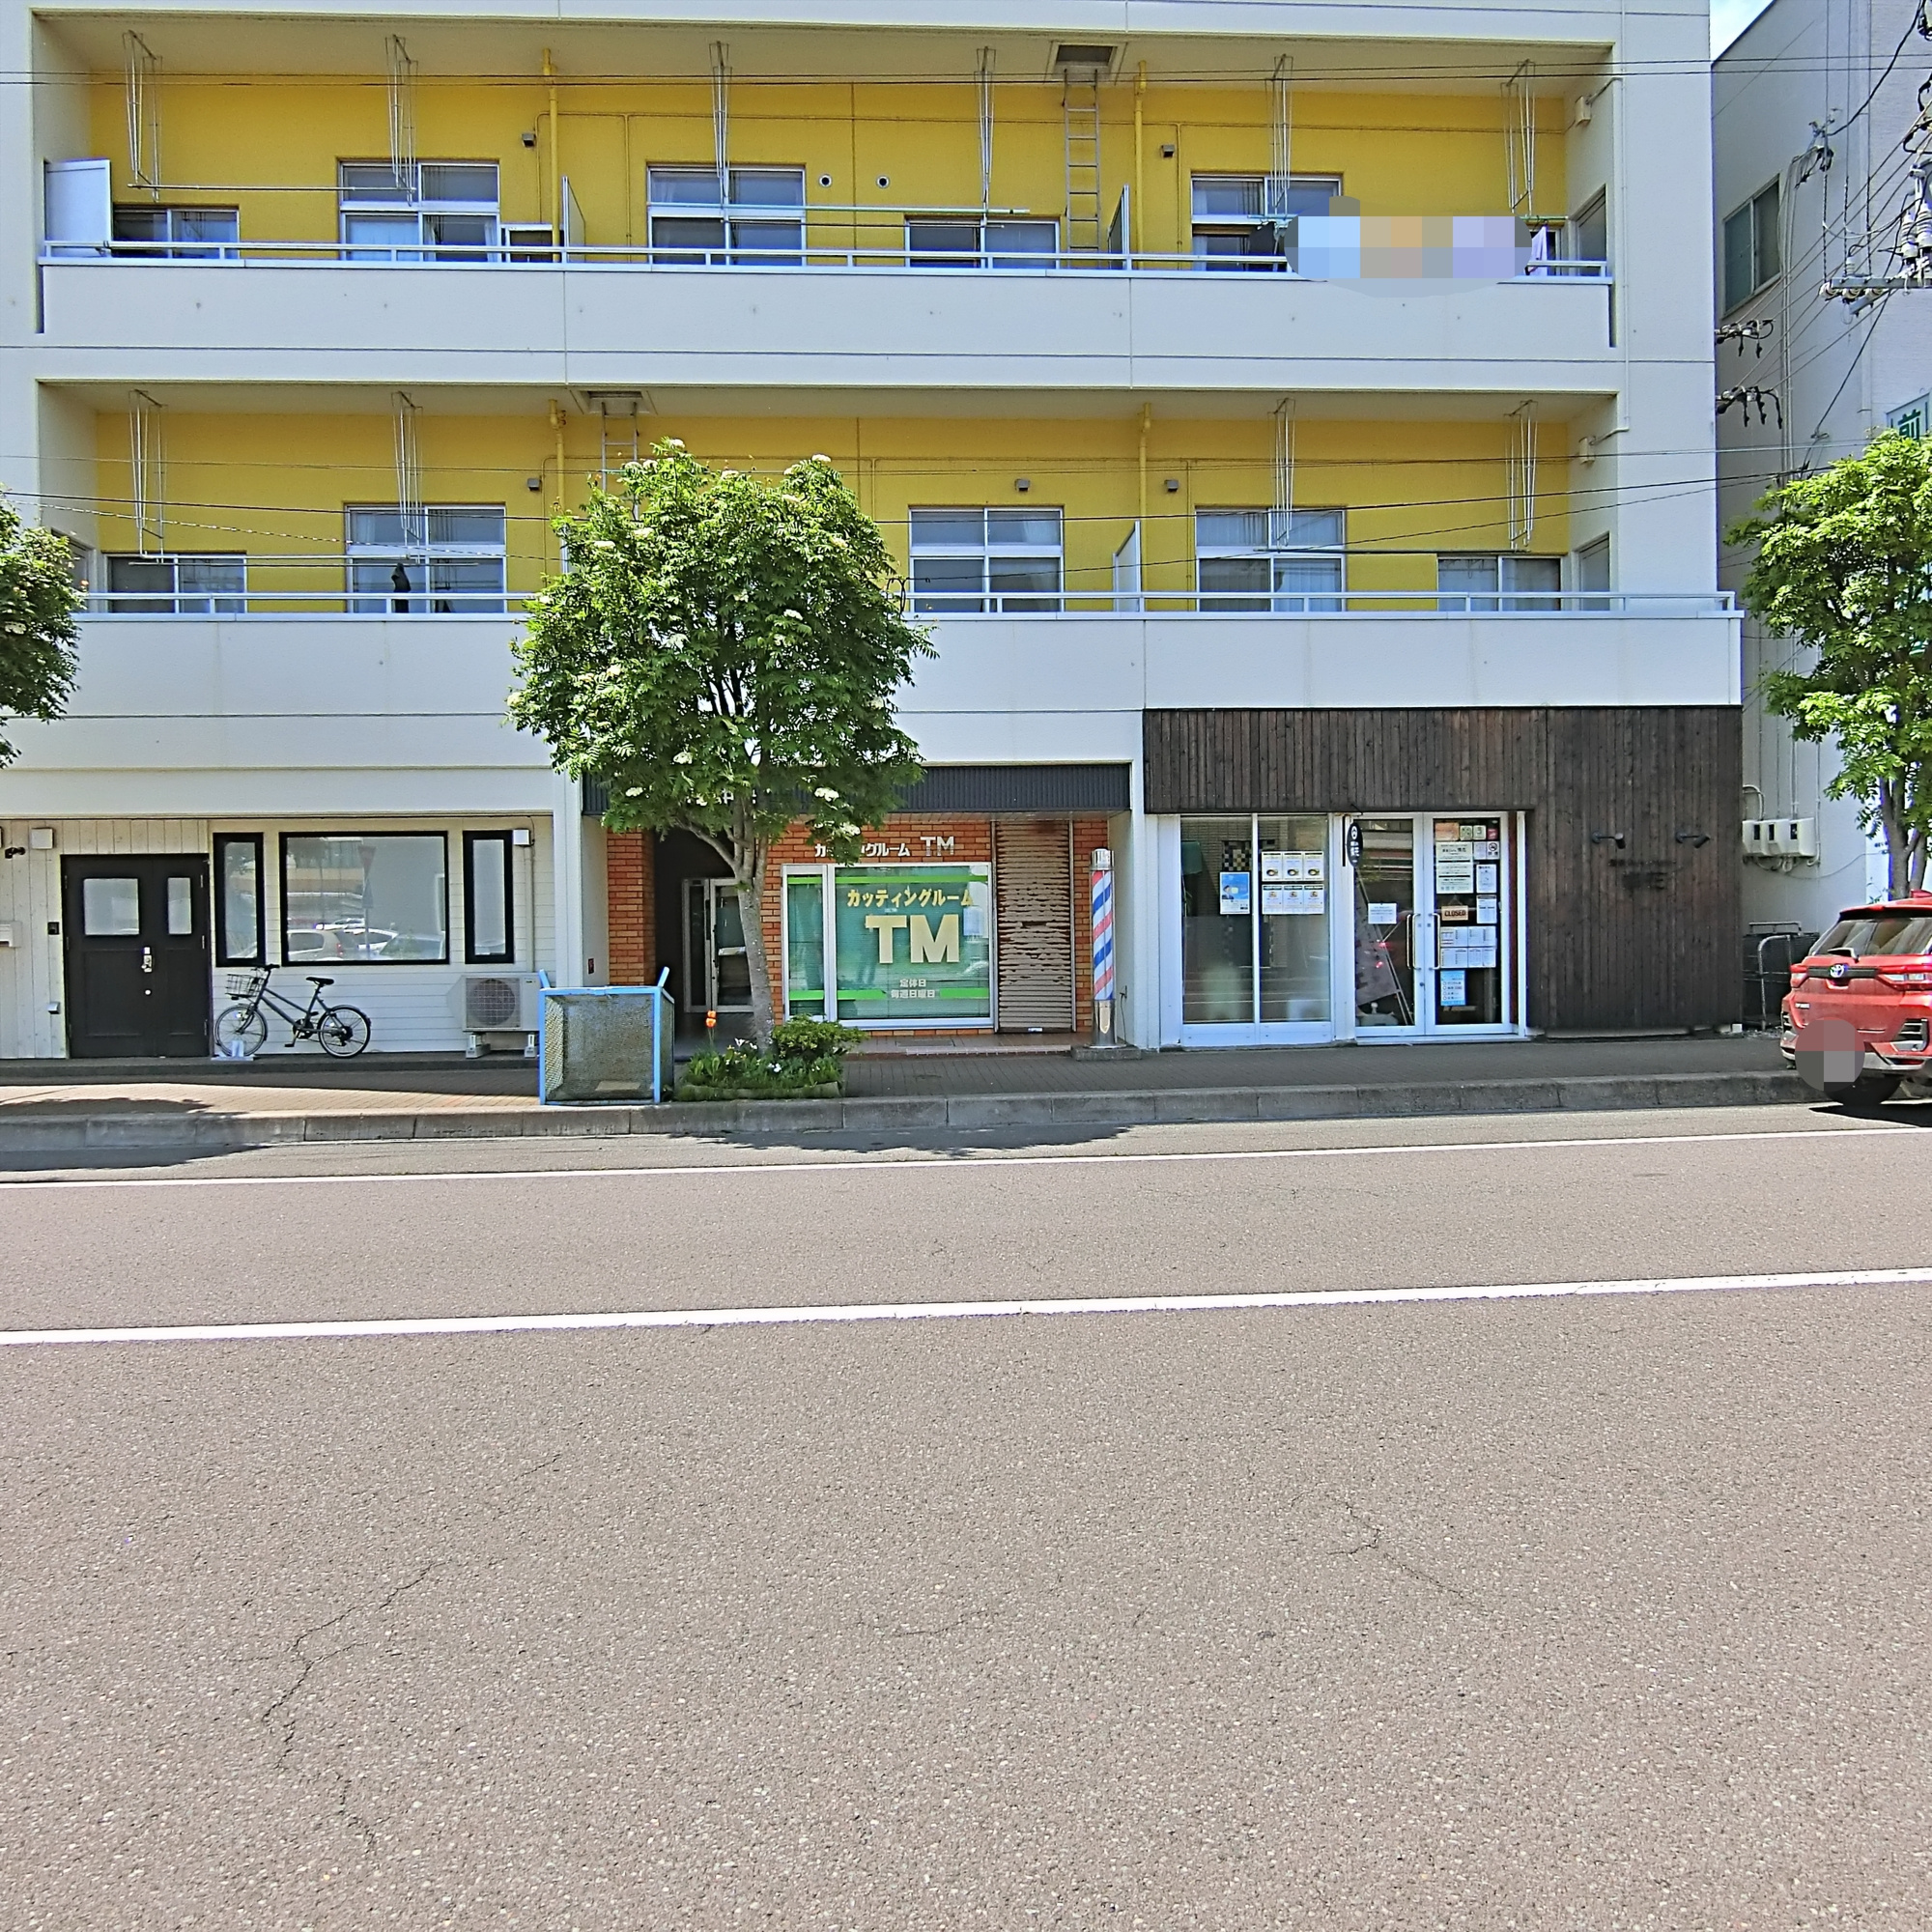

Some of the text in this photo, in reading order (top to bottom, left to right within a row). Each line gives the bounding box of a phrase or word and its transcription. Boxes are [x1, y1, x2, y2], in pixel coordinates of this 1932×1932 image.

[814, 836, 955, 858] カグルーム TM
[847, 888, 974, 908] カッティングルーム
[865, 914, 960, 964] TM
[899, 979, 926, 987] 定休日
